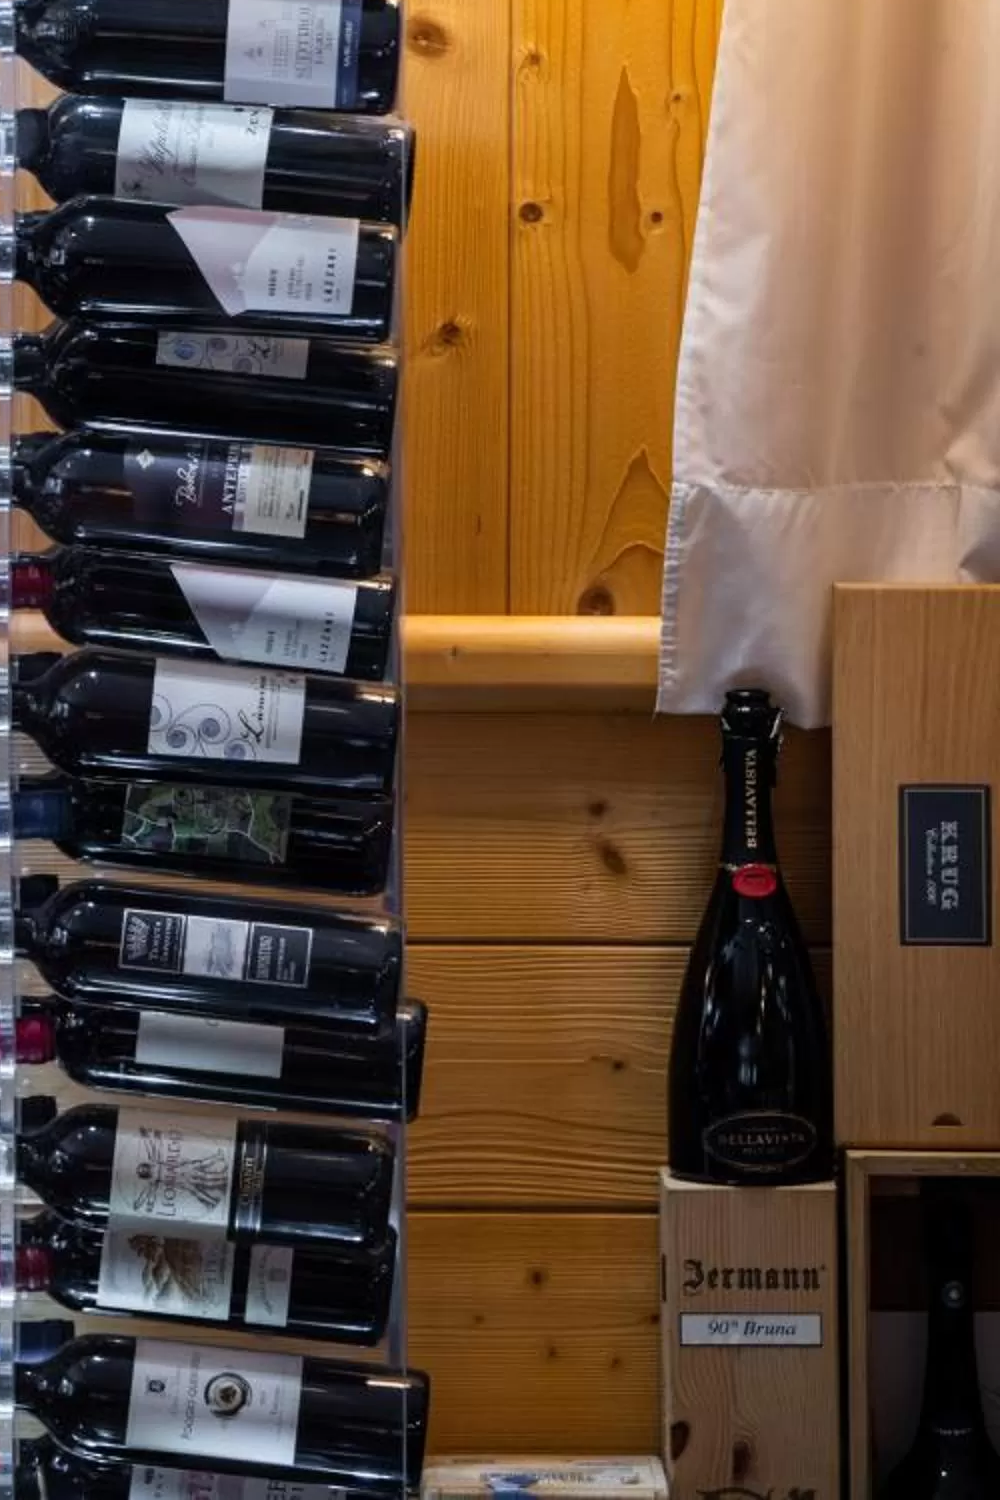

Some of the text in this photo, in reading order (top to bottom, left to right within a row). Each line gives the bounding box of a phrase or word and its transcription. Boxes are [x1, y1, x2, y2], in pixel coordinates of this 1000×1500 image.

[744, 748, 759, 849] BELLAVISTA
[940, 820, 959, 911] KRUG
[682, 1258, 820, 1298] Jermann
